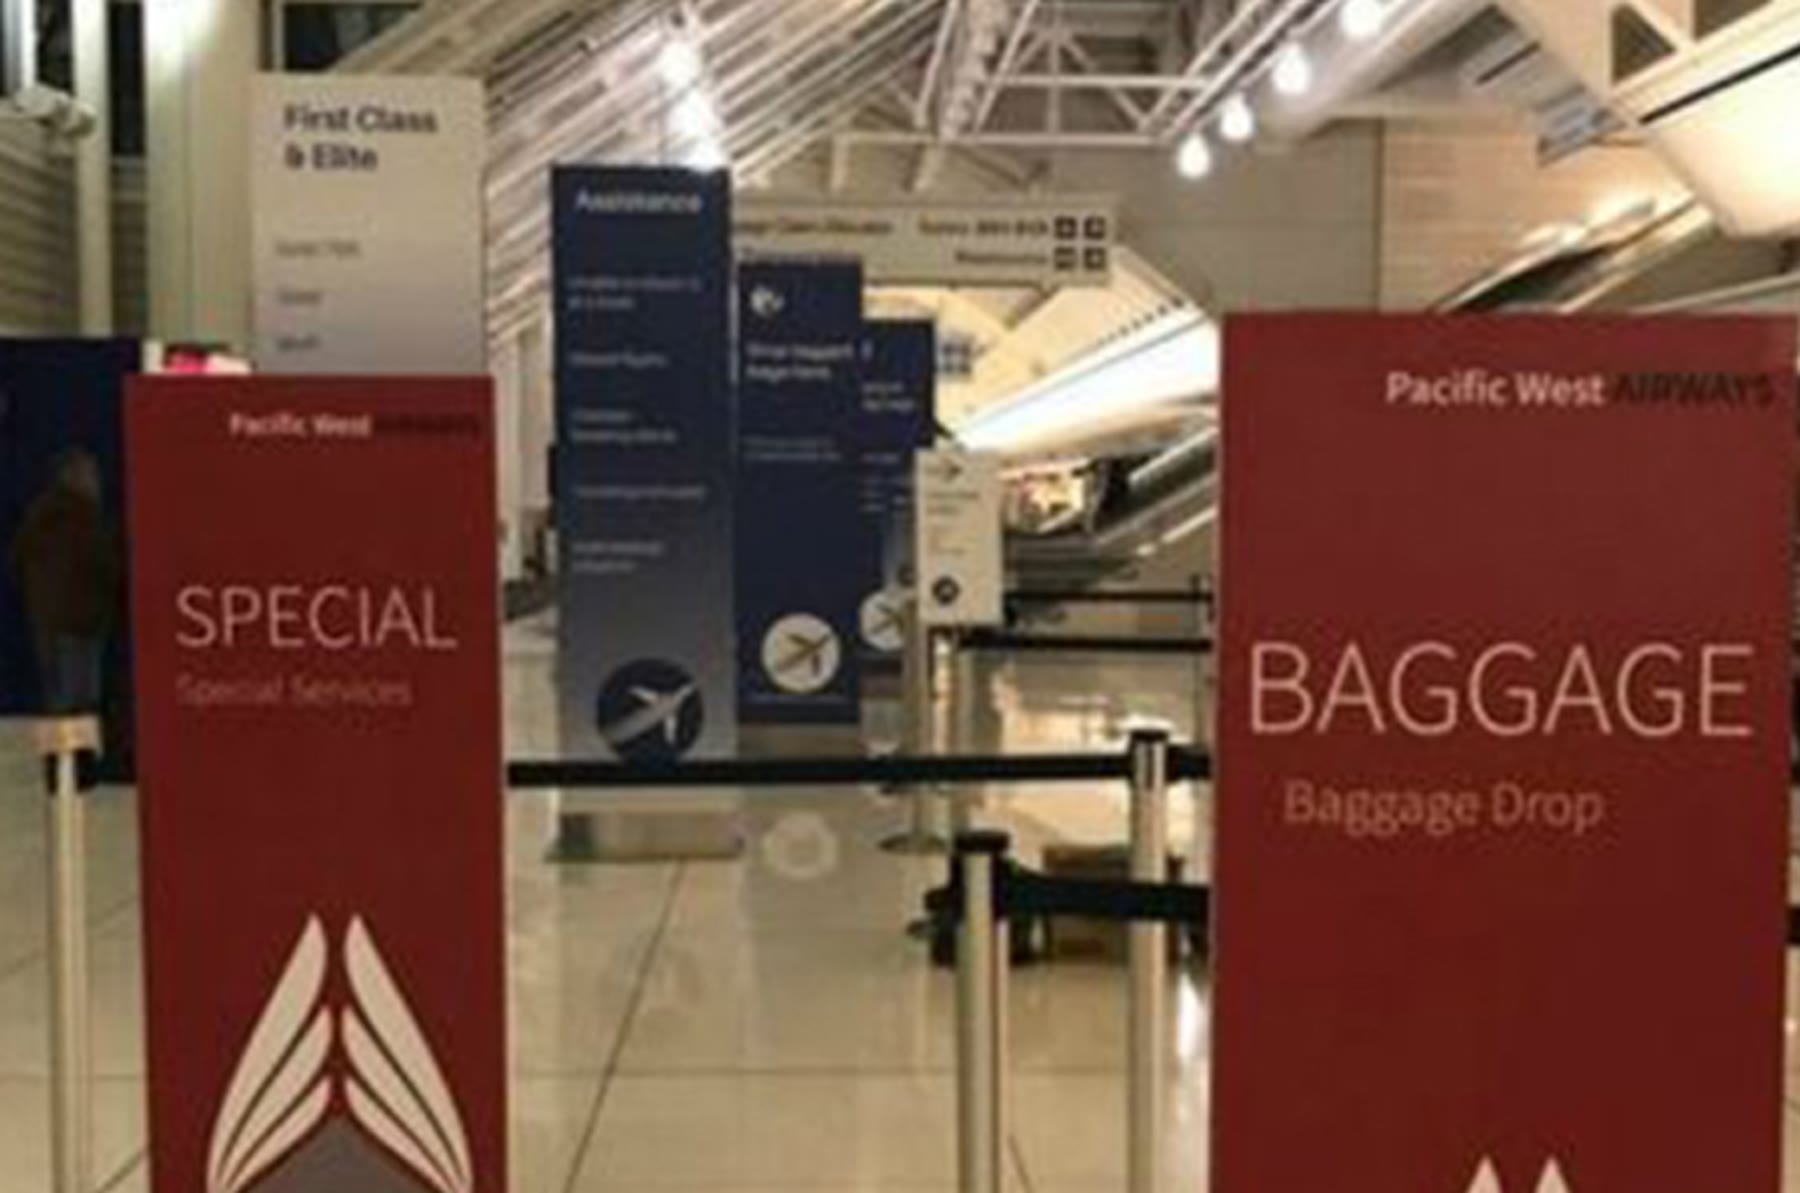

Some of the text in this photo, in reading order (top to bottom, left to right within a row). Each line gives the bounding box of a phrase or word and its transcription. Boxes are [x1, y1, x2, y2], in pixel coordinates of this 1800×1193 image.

[284, 104, 438, 133] First Class
[312, 144, 378, 171] Elite
[574, 189, 702, 215] Assistance
[1387, 371, 1775, 408] Pacific West AIRWAYS
[230, 412, 305, 436] Pacific
[313, 414, 372, 436] West
[176, 585, 458, 650] SPECIAL
[176, 675, 411, 710] Special Services
[1250, 641, 1754, 737] BAGGAGE
[1284, 778, 1604, 837] Baggage Drop
